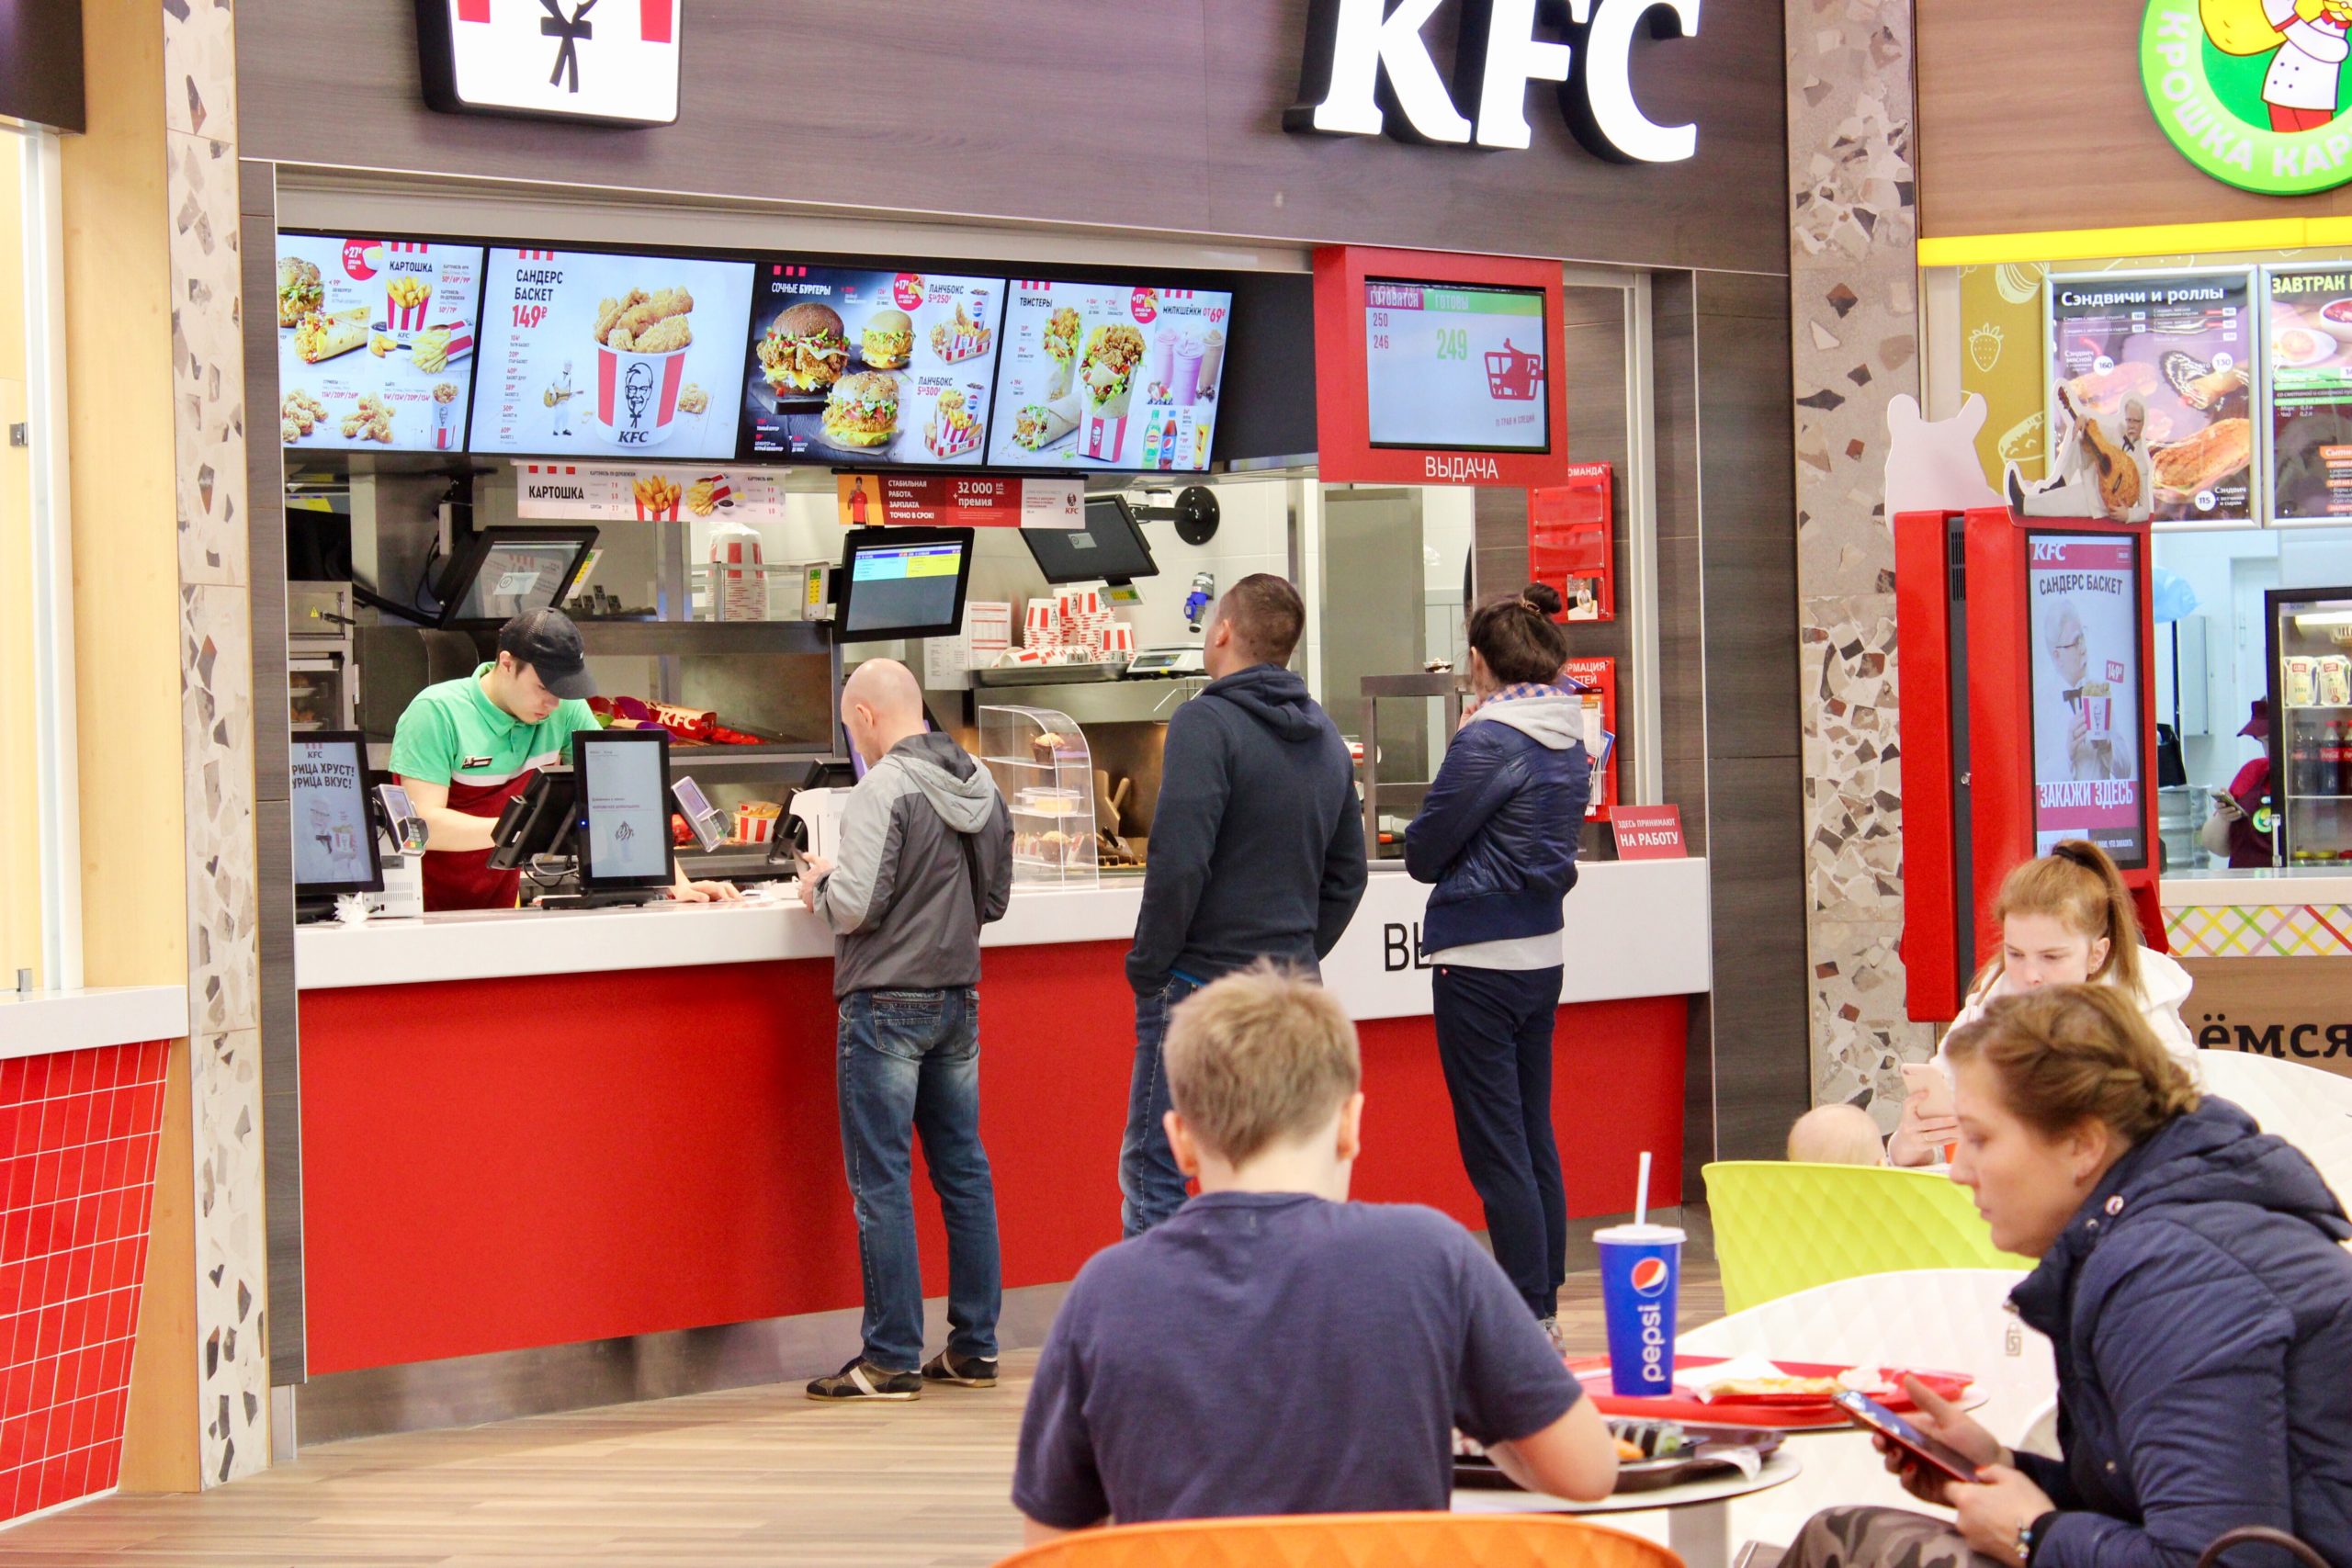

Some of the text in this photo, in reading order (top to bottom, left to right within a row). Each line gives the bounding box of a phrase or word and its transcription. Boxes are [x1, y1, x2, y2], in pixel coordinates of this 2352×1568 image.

[1314, 0, 1698, 163] KFC
[2156, 10, 2352, 177] КРОШКА КАР
[390, 261, 433, 273] КАРТОШКА
[516, 268, 563, 285] САНДЕРС
[772, 282, 797, 293] СОЧНЫЕ
[798, 284, 831, 296] БУРГЕРЫ
[929, 284, 965, 294] ЛАНЧБОКС
[2272, 275, 2346, 294] ЗАВТРАК
[514, 287, 553, 301] БАСКЕТ
[2061, 288, 2223, 308] Сэндвичи и роллы
[1020, 298, 1053, 308] ТВИСТЕРЫ
[1435, 294, 1469, 309] ГОТОВЫ
[1163, 304, 1202, 316] МИЛКШЕЙКИ
[1373, 313, 1388, 327] 250
[1374, 335, 1389, 349] 246
[1436, 329, 1467, 360] 249
[2215, 358, 2232, 367] 130
[919, 376, 953, 387] ЛАНЧБОКС
[617, 431, 649, 443] KFC
[1425, 456, 1499, 482] ВЫДАЧА
[888, 479, 927, 488] СТАБИЛЬНАЯ
[958, 482, 969, 493] 32
[971, 482, 992, 494] 000
[2215, 486, 2246, 494] Сэндвич
[528, 485, 584, 500] КАРТОШКА
[958, 498, 992, 509] премия
[890, 511, 911, 519] ТОЧНО
[2032, 543, 2066, 561] KFC
[2040, 574, 2122, 595] САНДЕРС БАСКЕТ
[658, 710, 696, 731] KFC
[320, 762, 355, 778] ХРУСТ!
[324, 776, 352, 790] ВКУС!
[2040, 779, 2133, 809] ЗАКАЖИ ЗДЕСЬ
[1618, 818, 1676, 829] ЗДЕСЬ ПРИНИМАЮТ
[1620, 831, 1679, 847] НА РАБОТУ
[1637, 1302, 1666, 1382] pepsi
